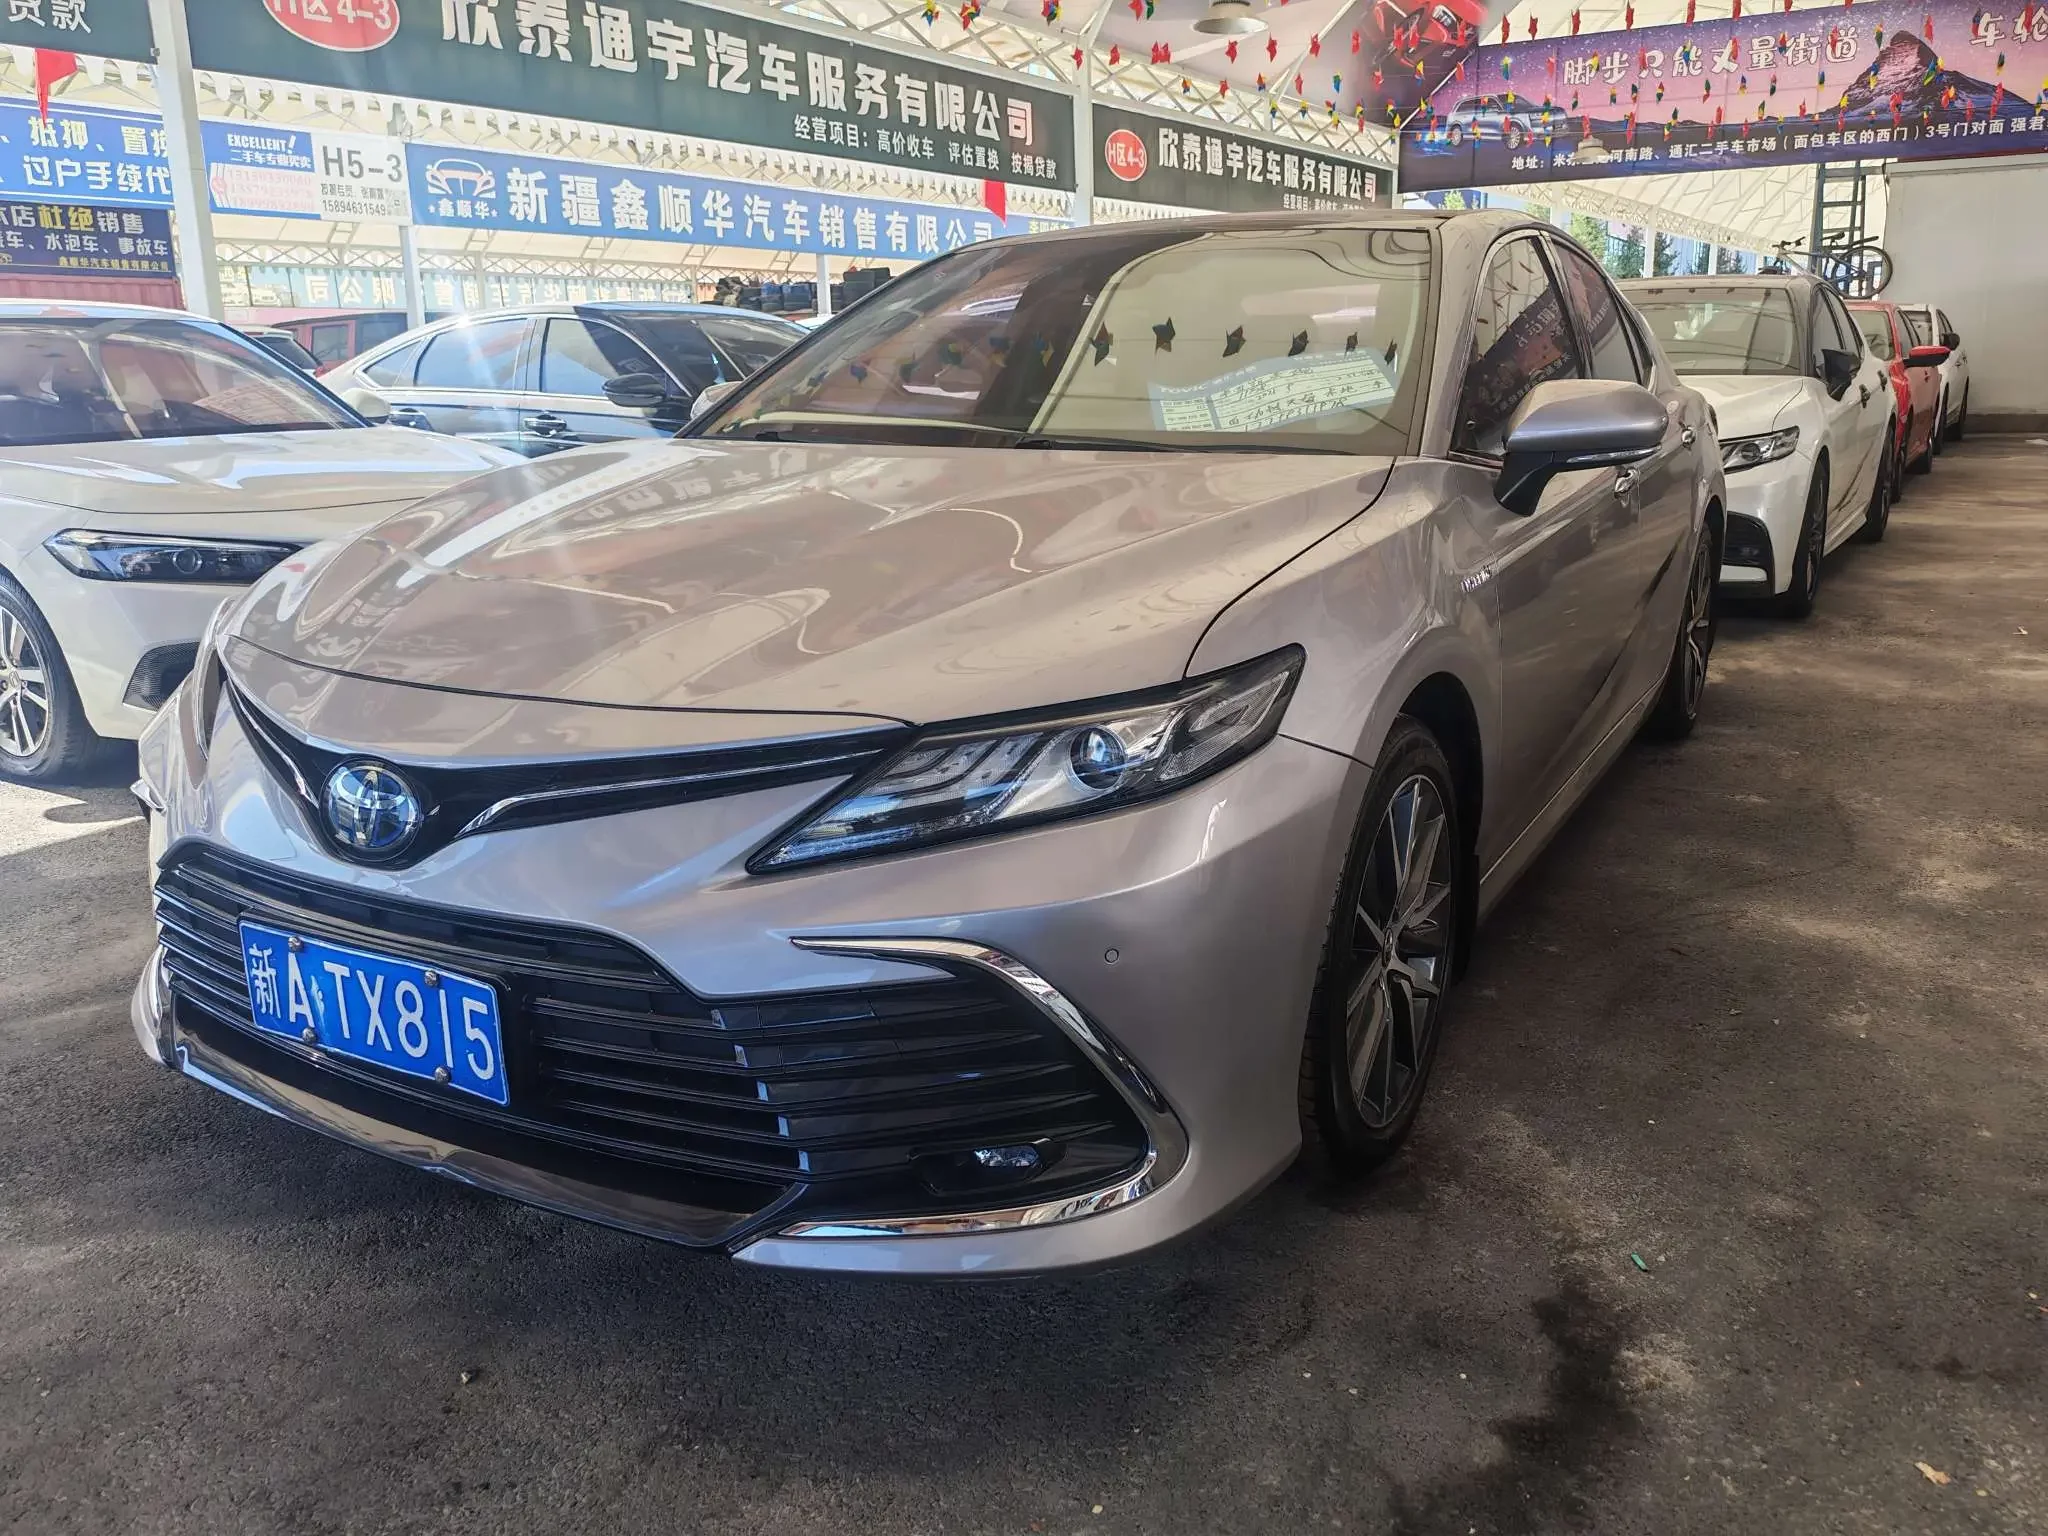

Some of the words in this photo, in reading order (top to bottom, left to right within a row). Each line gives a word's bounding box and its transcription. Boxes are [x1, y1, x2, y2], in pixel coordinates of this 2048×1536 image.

[441, 0, 1034, 146] 欣泰通宇汽车服务有限公司
[227, 134, 297, 154] EXCELLENT!
[322, 144, 404, 183] H5-3
[948, 141, 1000, 172] 评估置换
[1011, 151, 1058, 181] 按揭贷款
[1108, 141, 1145, 169] H区4-3
[1158, 127, 1377, 203] 欣泰通宇汽车服务有限公司
[506, 167, 992, 253] 新疆鑫顺华汽车销售有限公司
